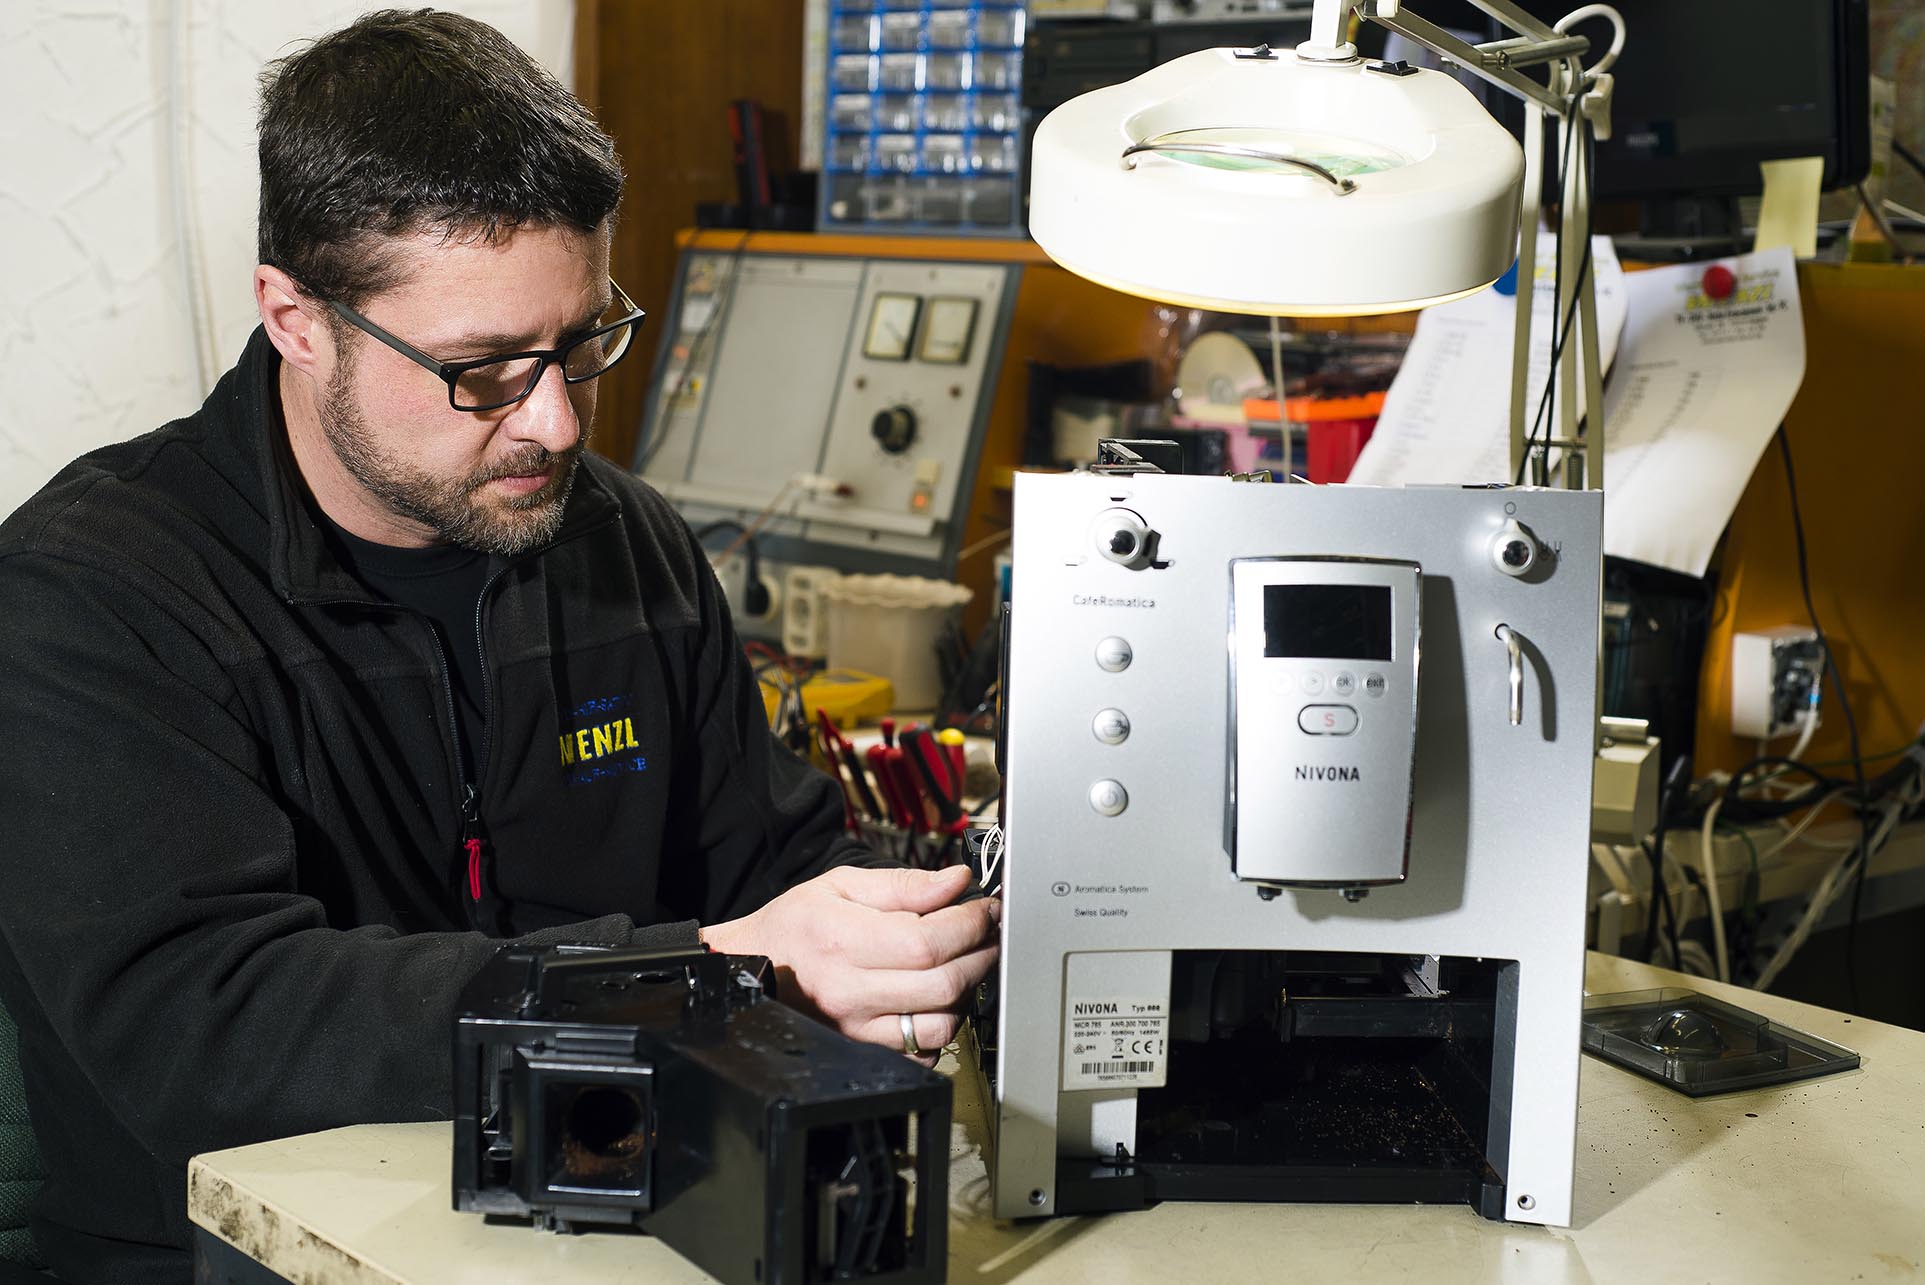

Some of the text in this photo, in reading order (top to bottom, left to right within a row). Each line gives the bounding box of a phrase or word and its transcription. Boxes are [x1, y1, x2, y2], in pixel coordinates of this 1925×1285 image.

[1072, 594, 1156, 608] CafeRomatica
[1324, 712, 1336, 728] S
[1295, 764, 1361, 782] NIVONA
[1074, 884, 1149, 895] Aromatica System
[1074, 908, 1128, 918] Swiss Quality
[1074, 1002, 1118, 1015] NIVONA
[1131, 1004, 1146, 1013] Typ
